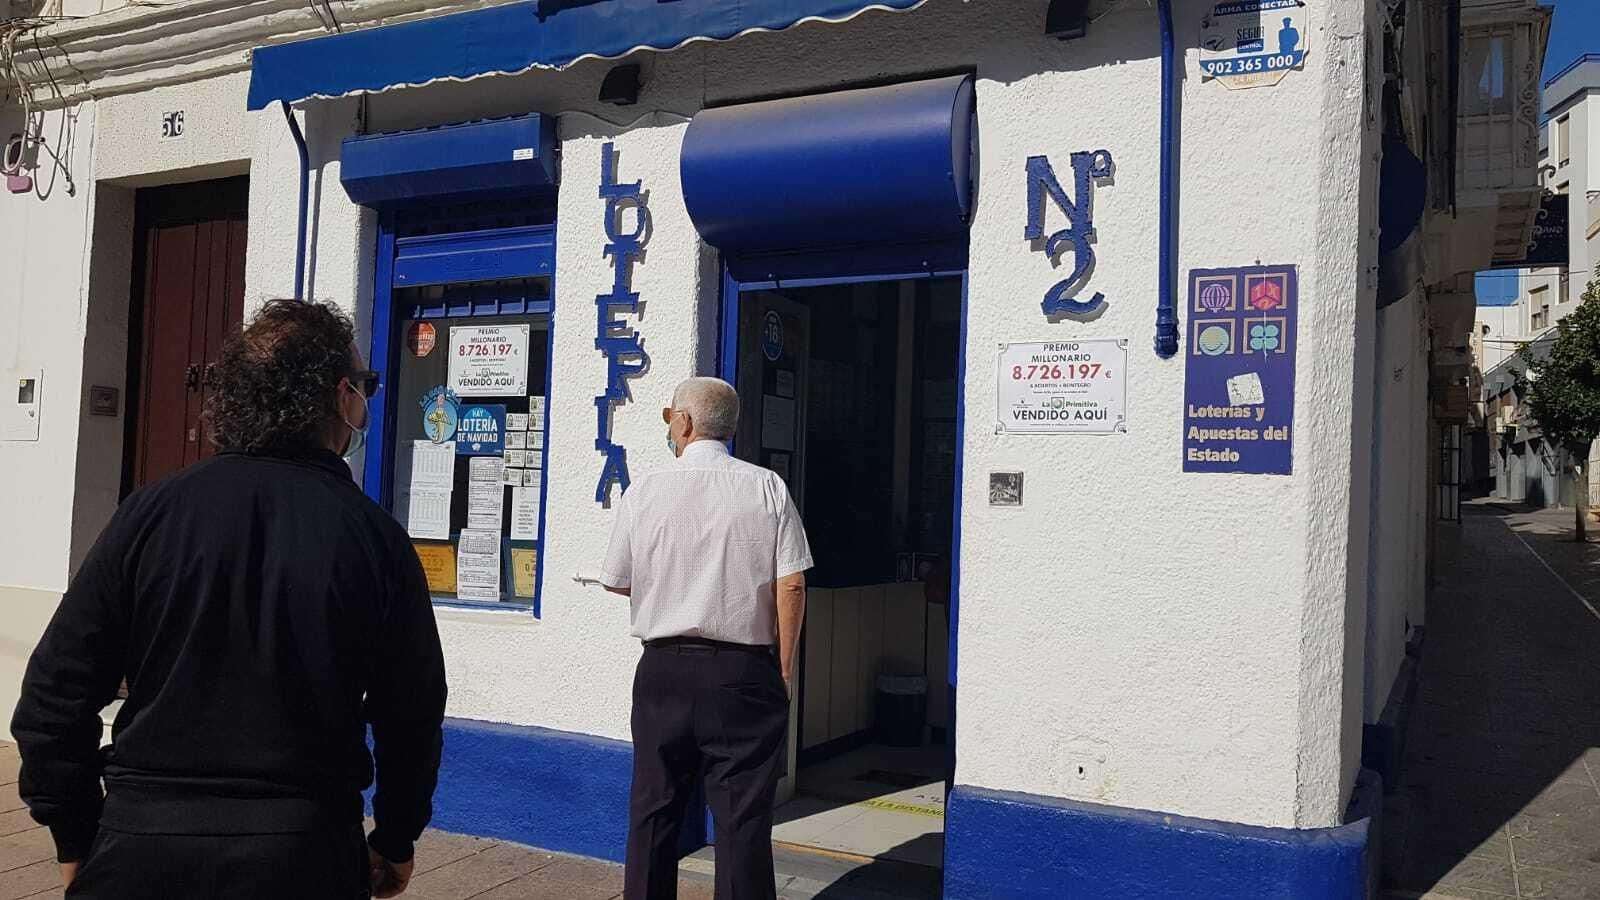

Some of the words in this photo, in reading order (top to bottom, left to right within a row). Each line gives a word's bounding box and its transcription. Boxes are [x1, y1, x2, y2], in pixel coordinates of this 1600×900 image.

[1207, 61, 1232, 74] 902
[1237, 58, 1262, 72] 365
[1267, 54, 1294, 69] 000
[162, 110, 184, 137] 56
[1040, 228, 1105, 316] 2
[459, 344, 512, 356] 8.726.197
[1043, 343, 1080, 352] PREMIO
[1031, 353, 1091, 363] MILLONARIO
[1012, 363, 1102, 380] 8.726.197
[1105, 370, 1112, 379] €
[458, 378, 492, 386] VENDIDO
[494, 376, 515, 386] AQUÍ
[1065, 400, 1098, 408] Primitiva
[1013, 410, 1069, 420] VENDIDO
[1074, 407, 1107, 421] AQUÍ
[1255, 406, 1265, 421] y
[457, 416, 498, 432] LOTERÍA
[457, 433, 467, 442] DE
[467, 433, 498, 442] NAVIDAD
[1187, 426, 1259, 443] Apuestas
[1263, 425, 1288, 440] del
[1187, 447, 1240, 462] Estado
